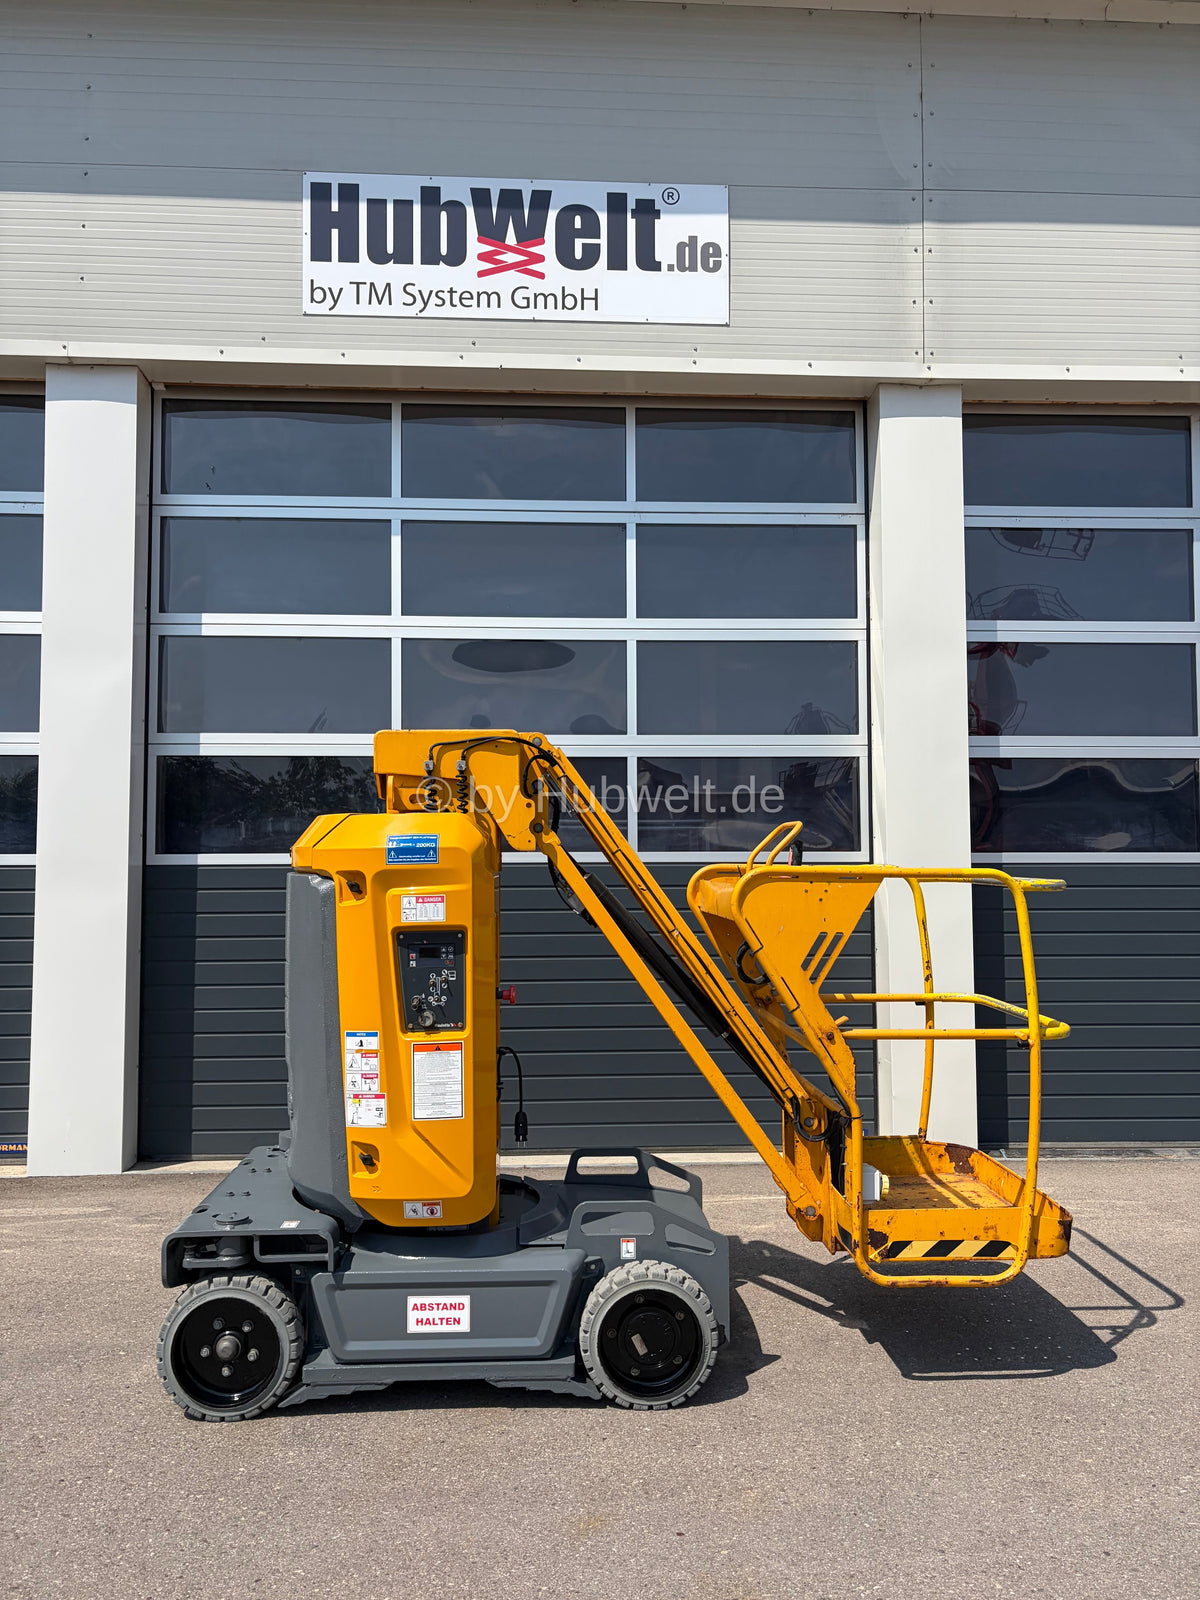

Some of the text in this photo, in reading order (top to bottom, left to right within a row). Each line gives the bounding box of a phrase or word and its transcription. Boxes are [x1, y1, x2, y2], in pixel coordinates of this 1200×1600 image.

[310, 279, 599, 313] by TM System GmbH
[411, 1302, 465, 1311] ABSTAND
[416, 1317, 461, 1326] HALTEN
